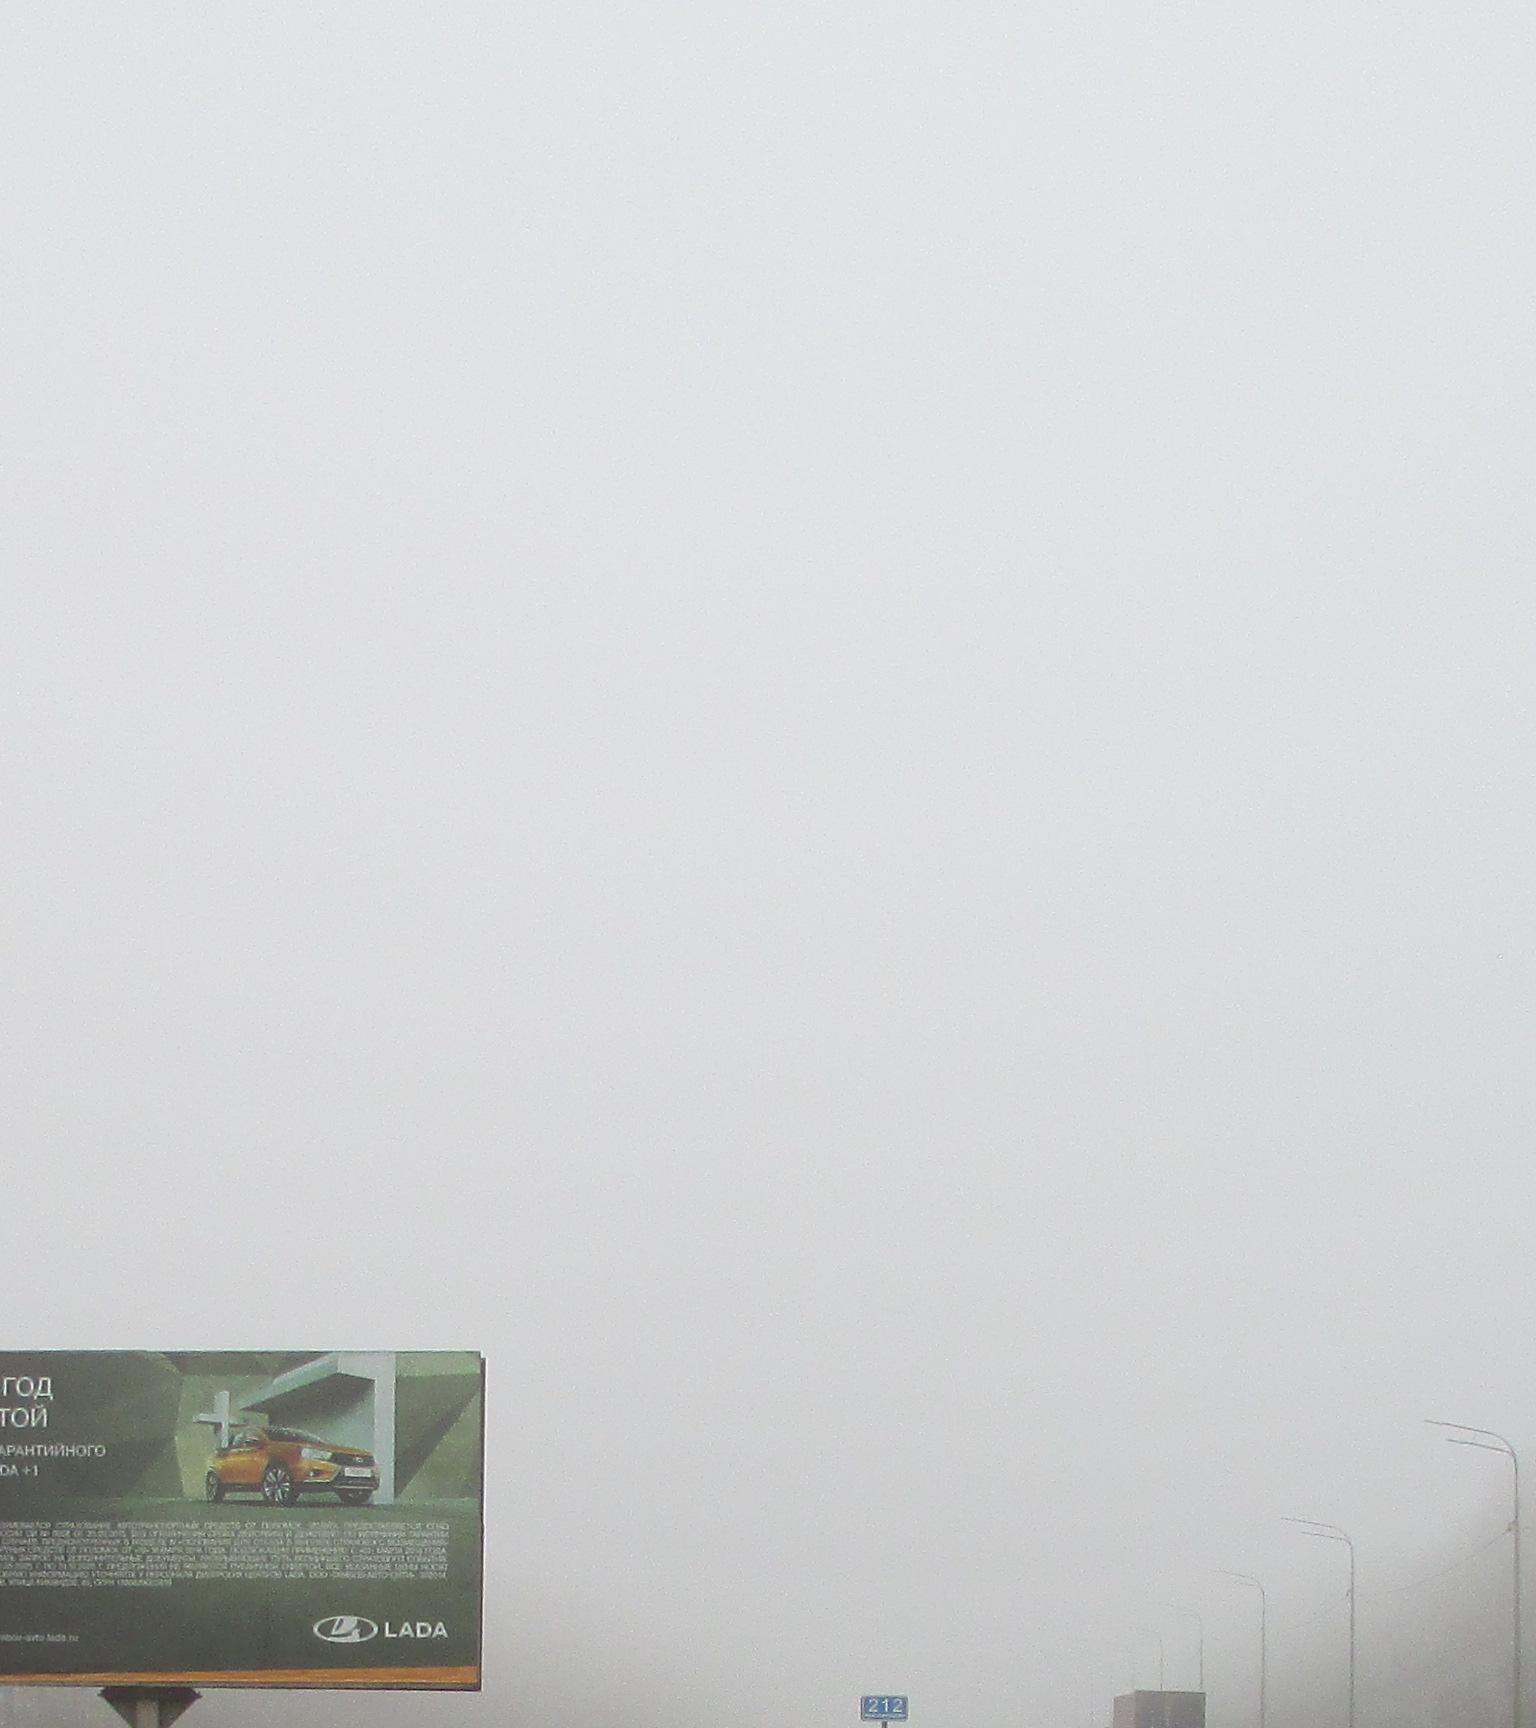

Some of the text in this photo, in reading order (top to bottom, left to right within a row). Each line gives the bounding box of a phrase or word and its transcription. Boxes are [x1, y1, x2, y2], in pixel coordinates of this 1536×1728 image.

[2, 1376, 54, 1400] ГОД
[23, 1464, 39, 1477] +1
[384, 1622, 448, 1638] LADA
[868, 1698, 903, 1713] 212
